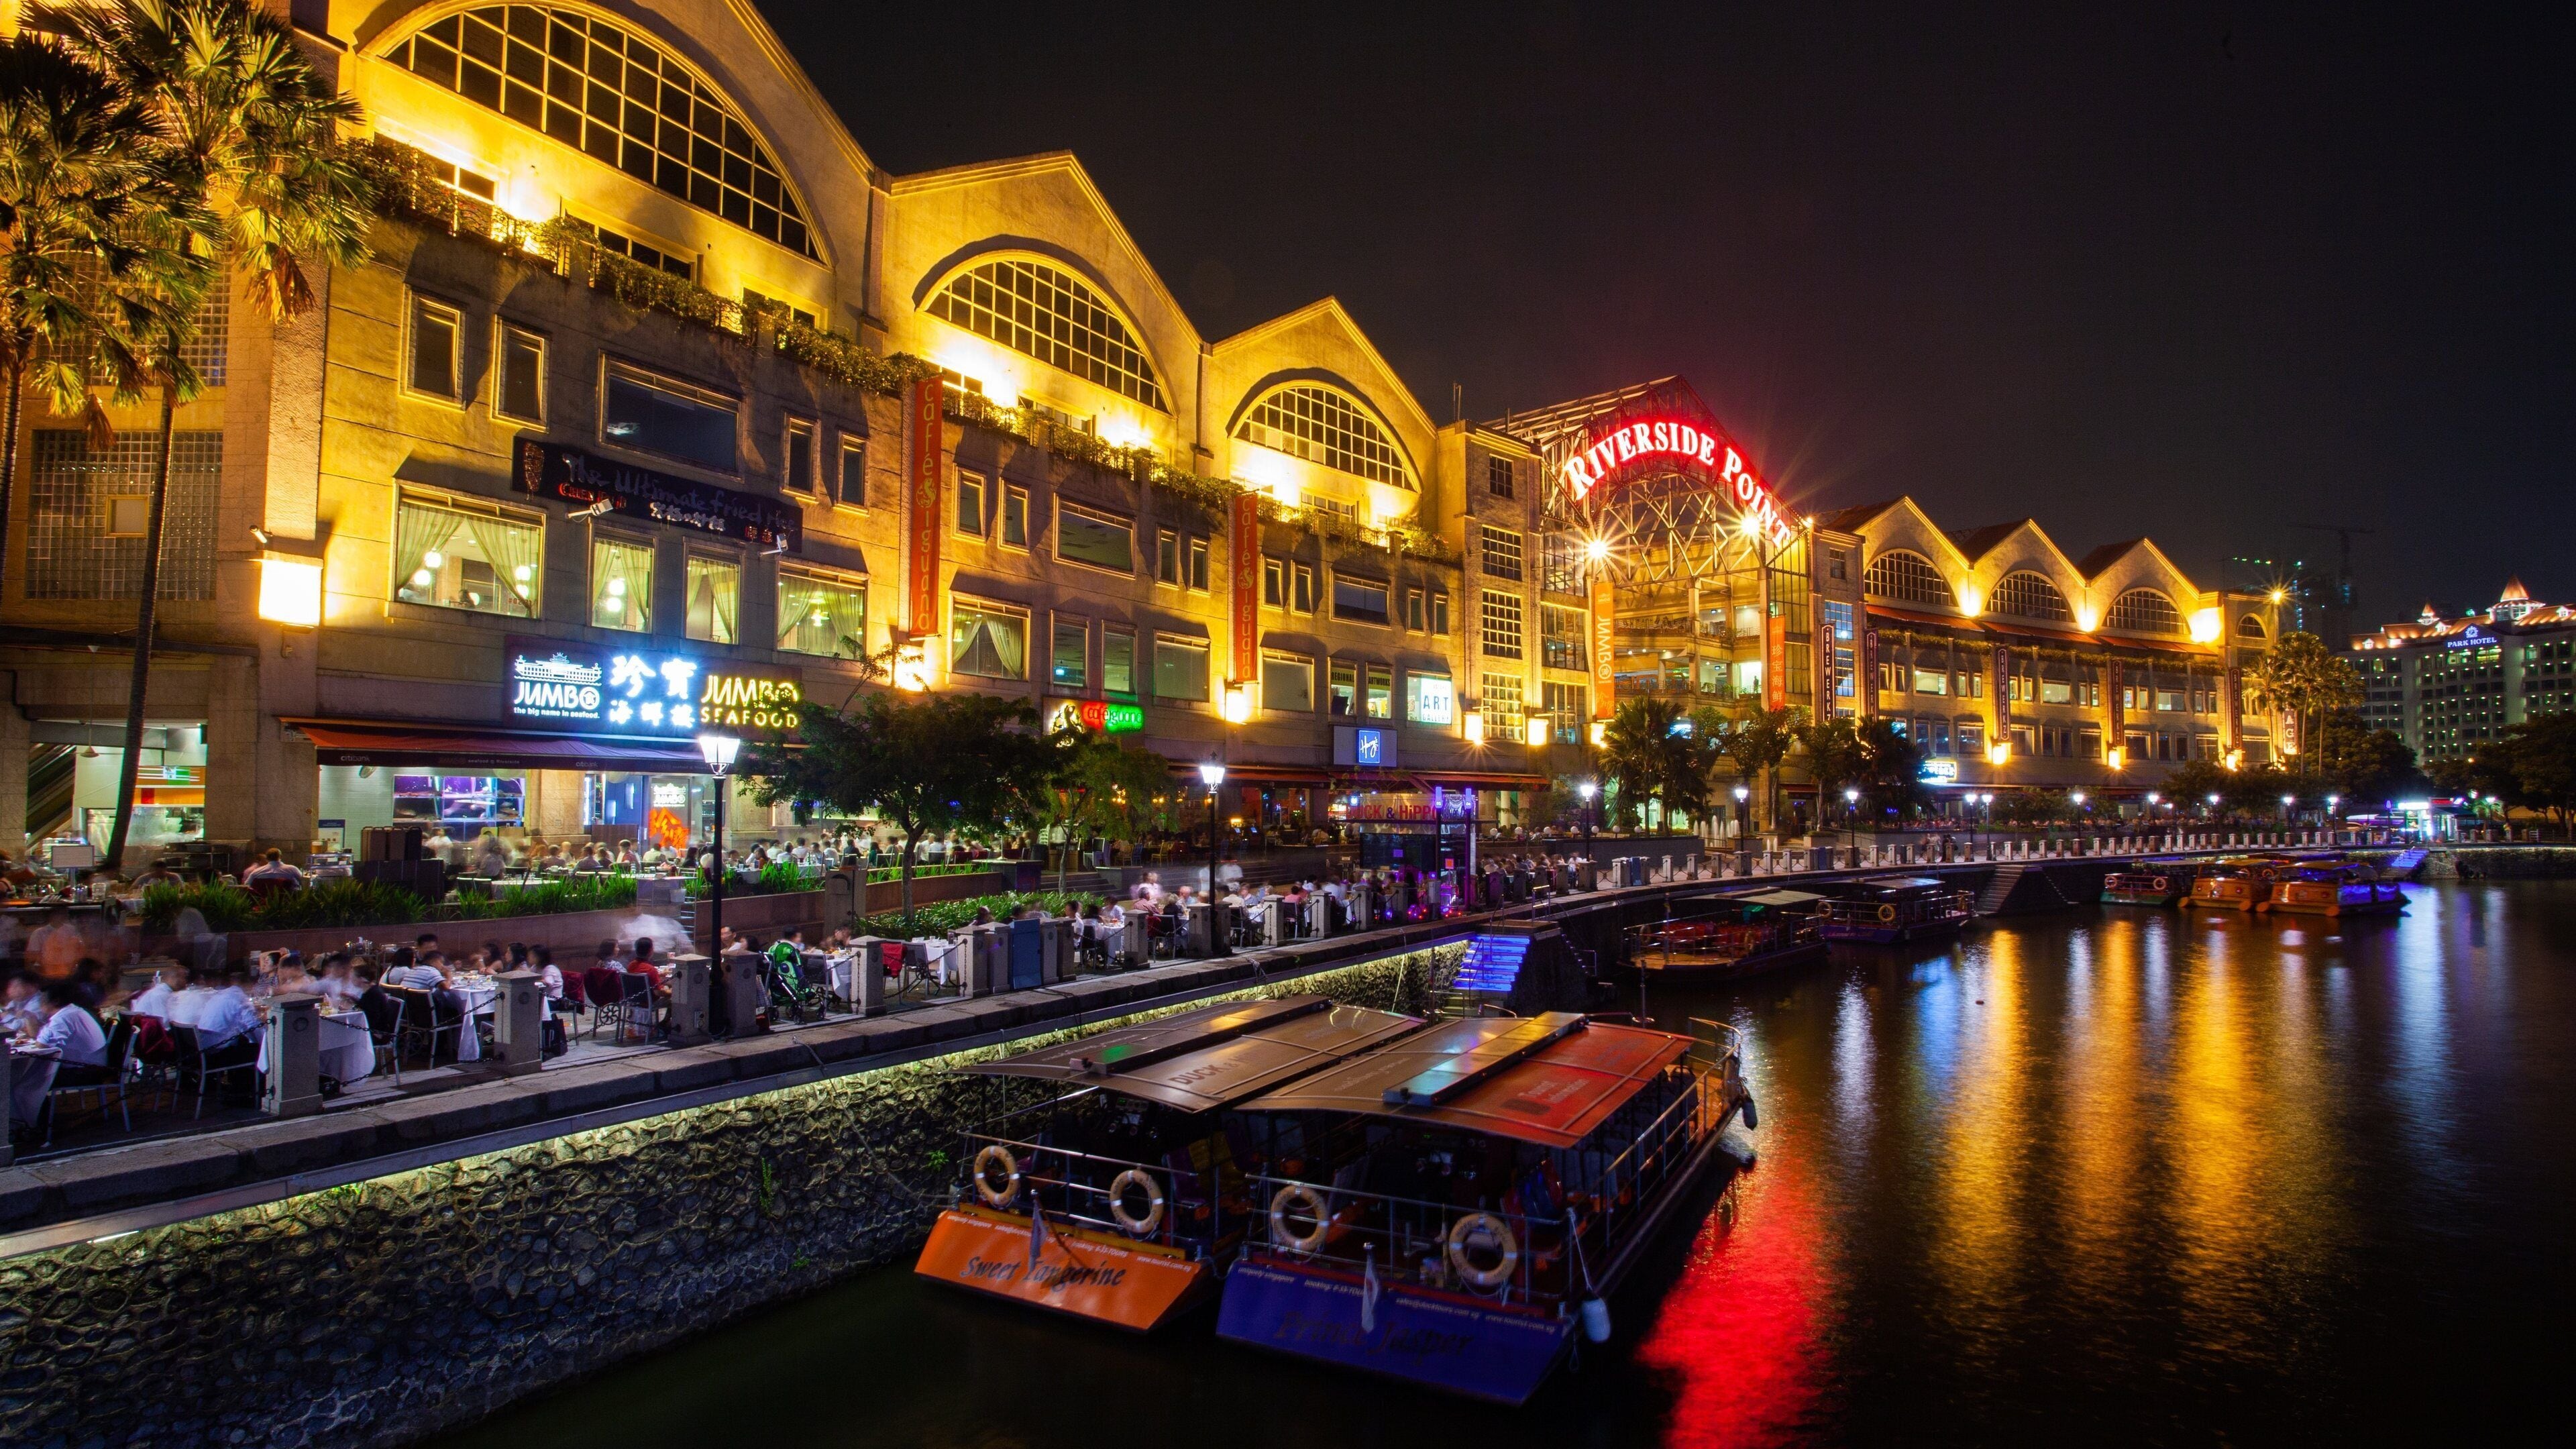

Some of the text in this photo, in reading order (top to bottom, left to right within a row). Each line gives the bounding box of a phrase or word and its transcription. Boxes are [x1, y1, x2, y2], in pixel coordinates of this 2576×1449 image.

[561, 453, 611, 487] The
[614, 470, 709, 511] Ultimate
[1564, 422, 1792, 549] RIVERSIDE POINT
[1597, 614, 1612, 680] JUMBO
[2447, 637, 2497, 648] PARK HOTEL
[1332, 672, 1354, 683] REGIONAL
[514, 682, 600, 710] JUMBO
[701, 675, 798, 711] JUMBO
[1424, 695, 1449, 711] ART
[528, 708, 539, 716] big
[541, 709, 561, 717] name
[570, 711, 600, 719] seafood.
[701, 706, 798, 728] SEAFOOD
[1423, 713, 1449, 723] GALLERY
[341, 754, 370, 762] citibank
[1387, 807, 1395, 818] &
[960, 1256, 1127, 1292] Sweet Tangerine
